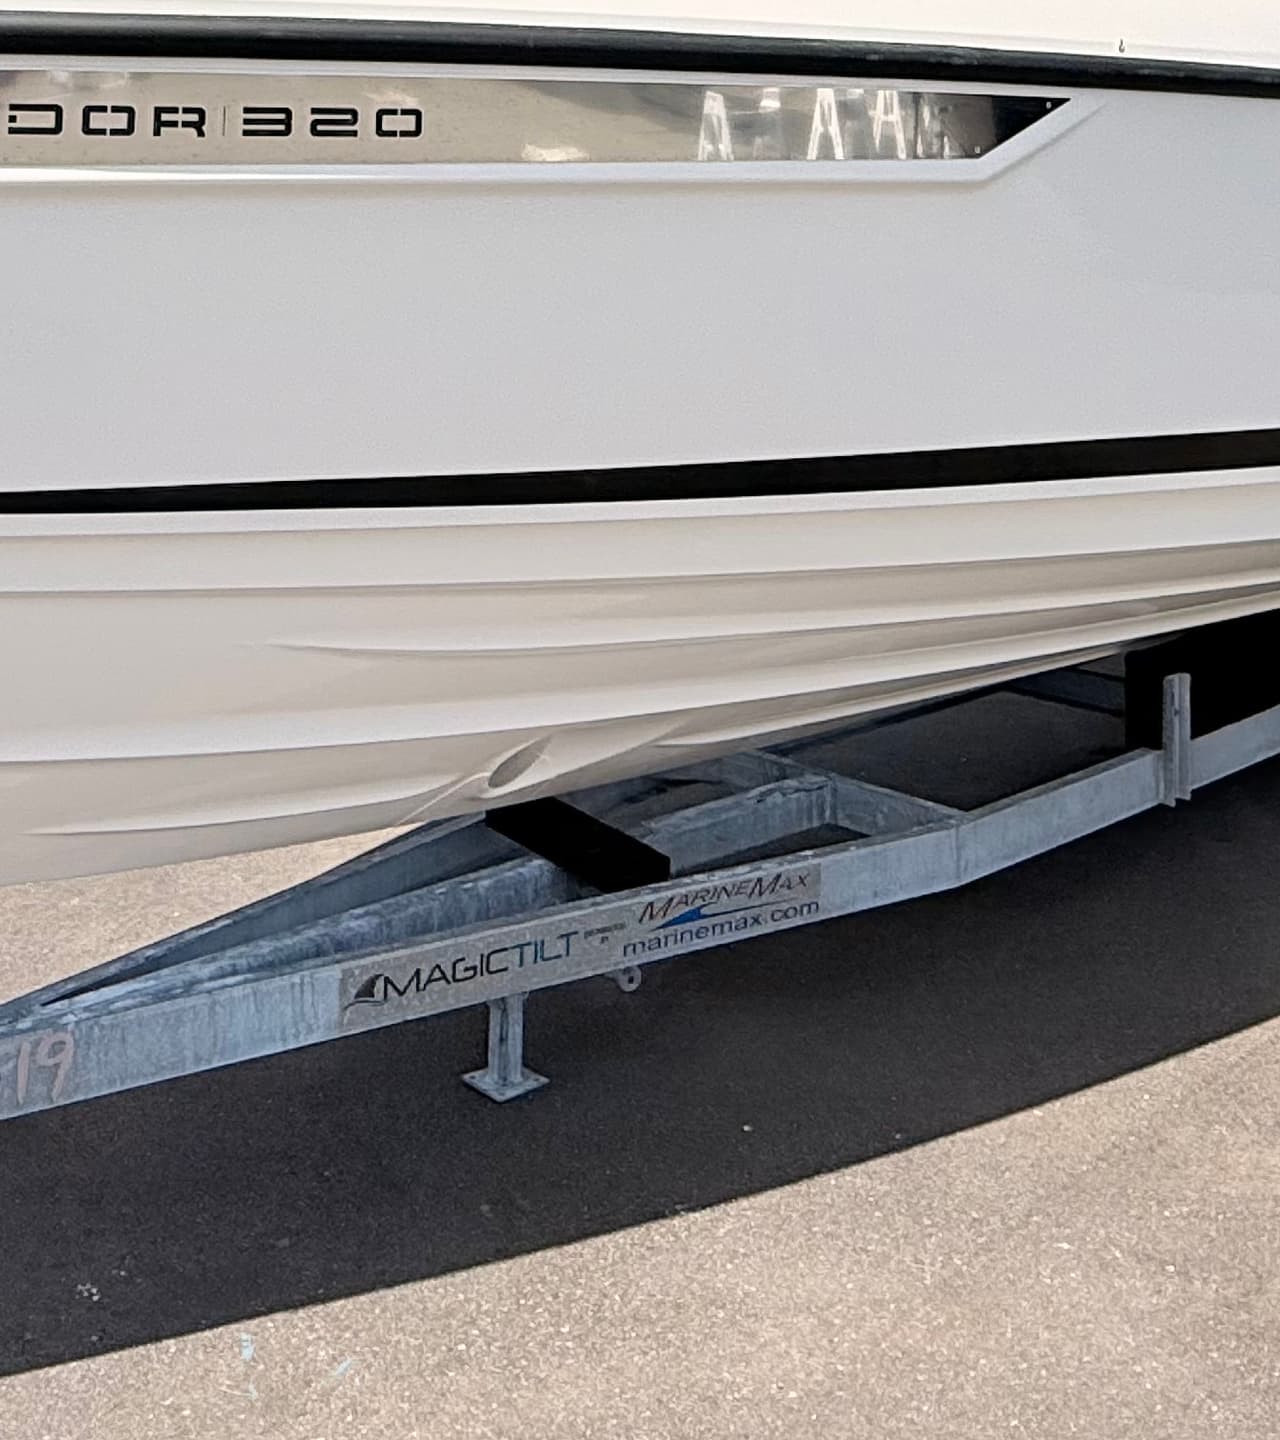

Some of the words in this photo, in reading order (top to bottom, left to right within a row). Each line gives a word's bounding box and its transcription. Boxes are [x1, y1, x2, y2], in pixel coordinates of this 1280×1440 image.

[242, 106, 423, 138] 320
[623, 900, 820, 958] marinemax.com
[383, 930, 579, 1002] MAGICTILT
[16, 1031, 75, 1106] 19
